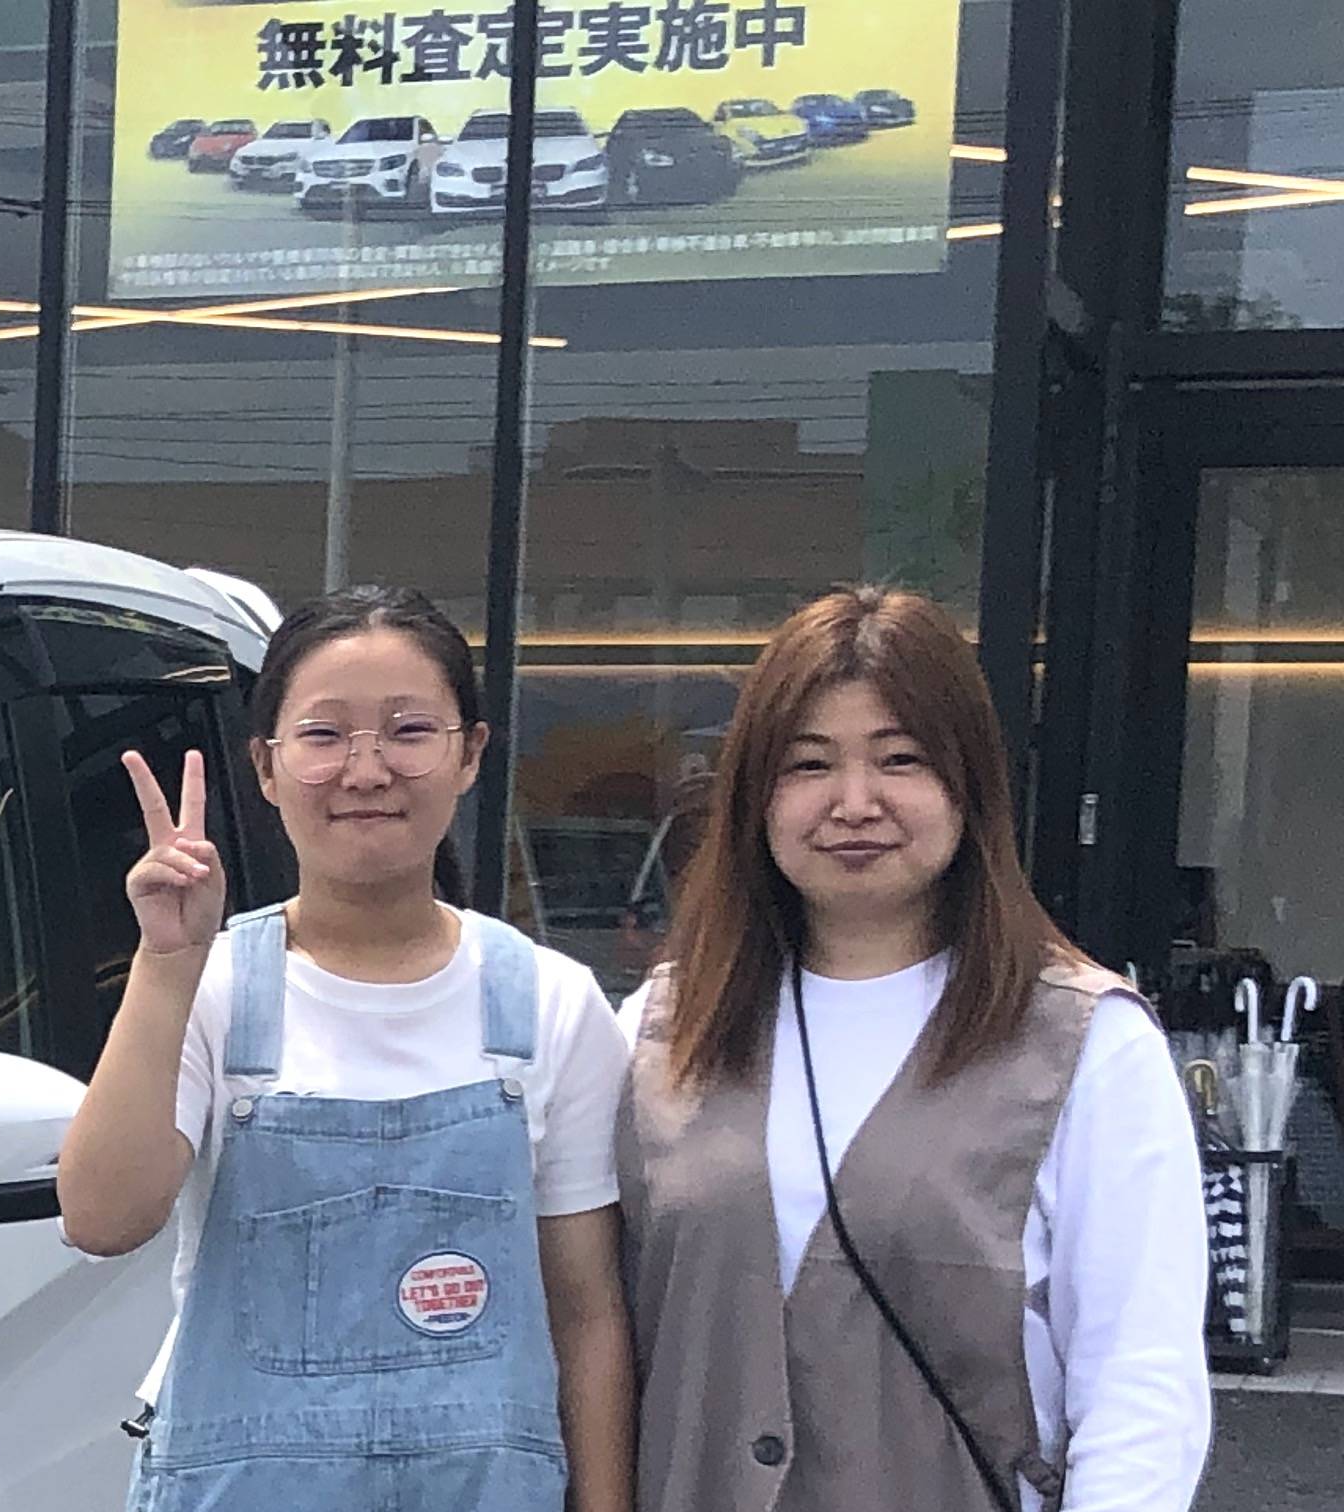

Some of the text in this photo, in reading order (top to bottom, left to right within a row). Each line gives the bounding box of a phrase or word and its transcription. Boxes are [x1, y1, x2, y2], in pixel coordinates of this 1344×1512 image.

[256, 1, 806, 90] 無料査定実施中
